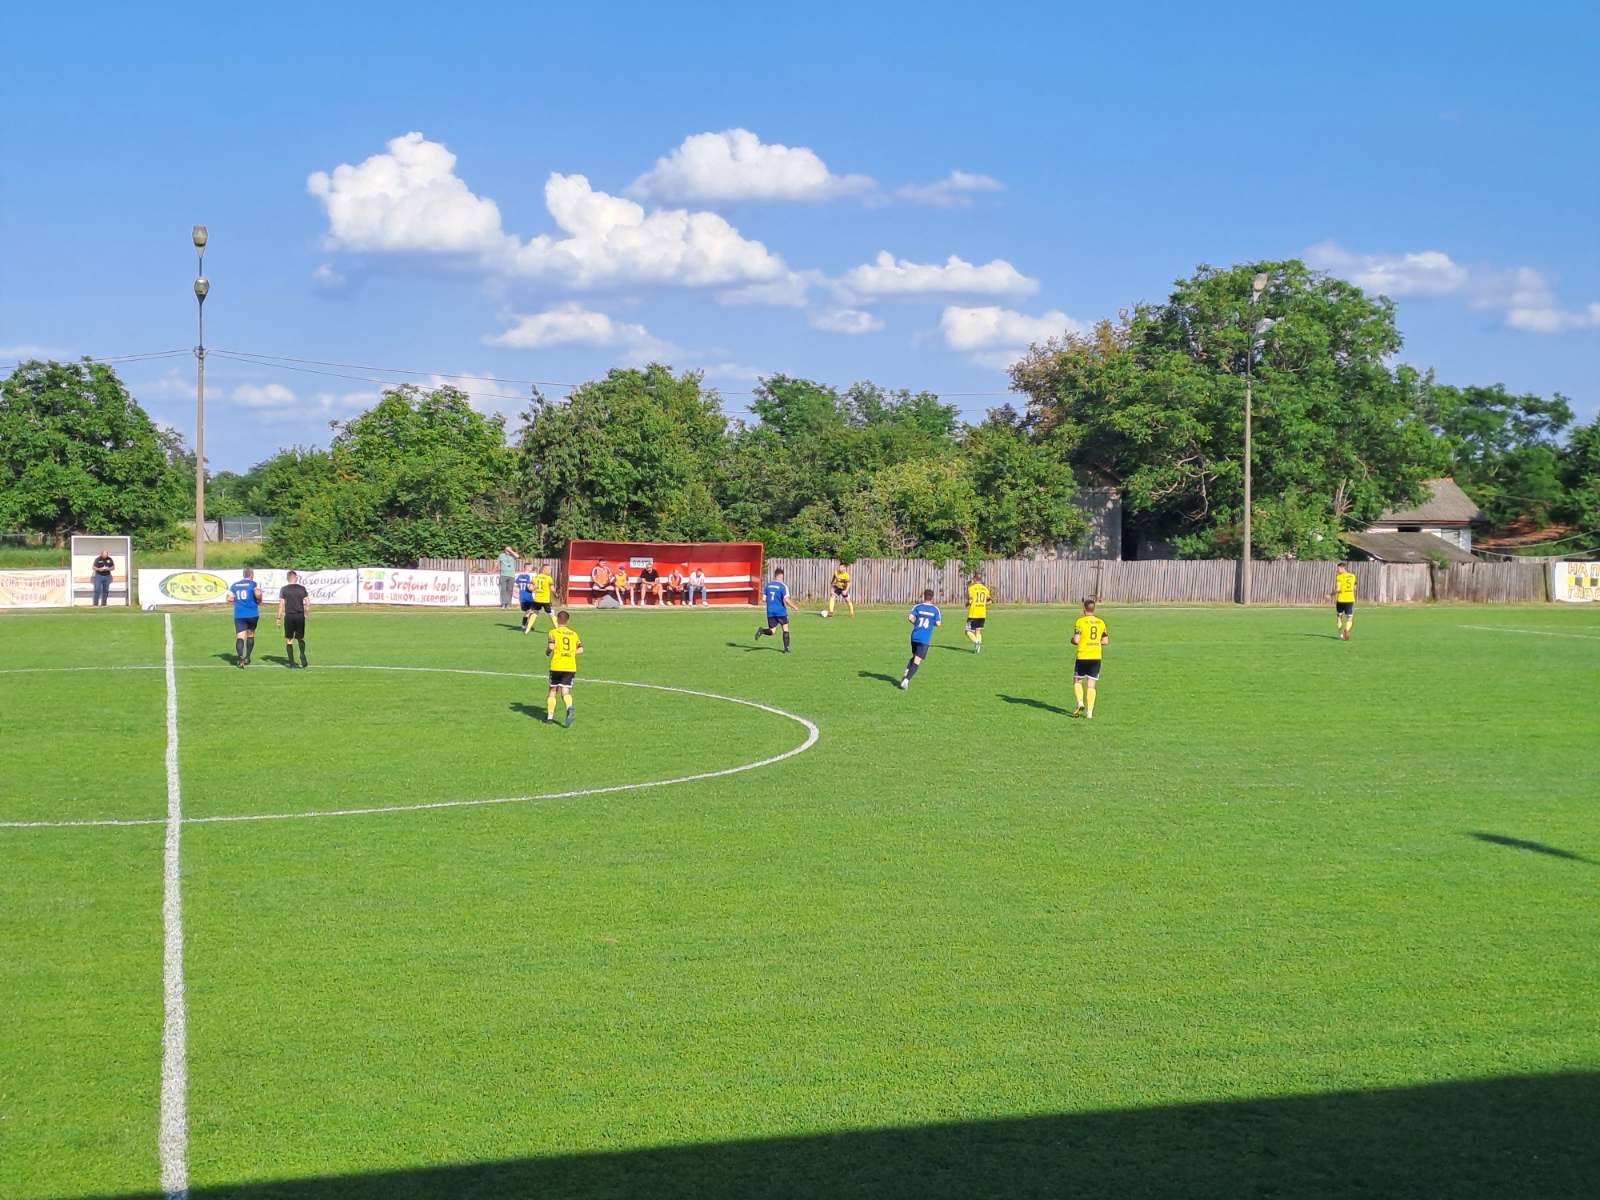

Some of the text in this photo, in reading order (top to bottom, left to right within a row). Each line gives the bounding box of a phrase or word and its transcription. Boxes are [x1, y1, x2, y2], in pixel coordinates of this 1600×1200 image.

[236, 590, 247, 600] 10
[769, 591, 775, 601] 7
[976, 591, 986, 603] 10
[918, 617, 929, 629] 14
[1090, 626, 1097, 640] 8
[562, 637, 570, 651] 9
